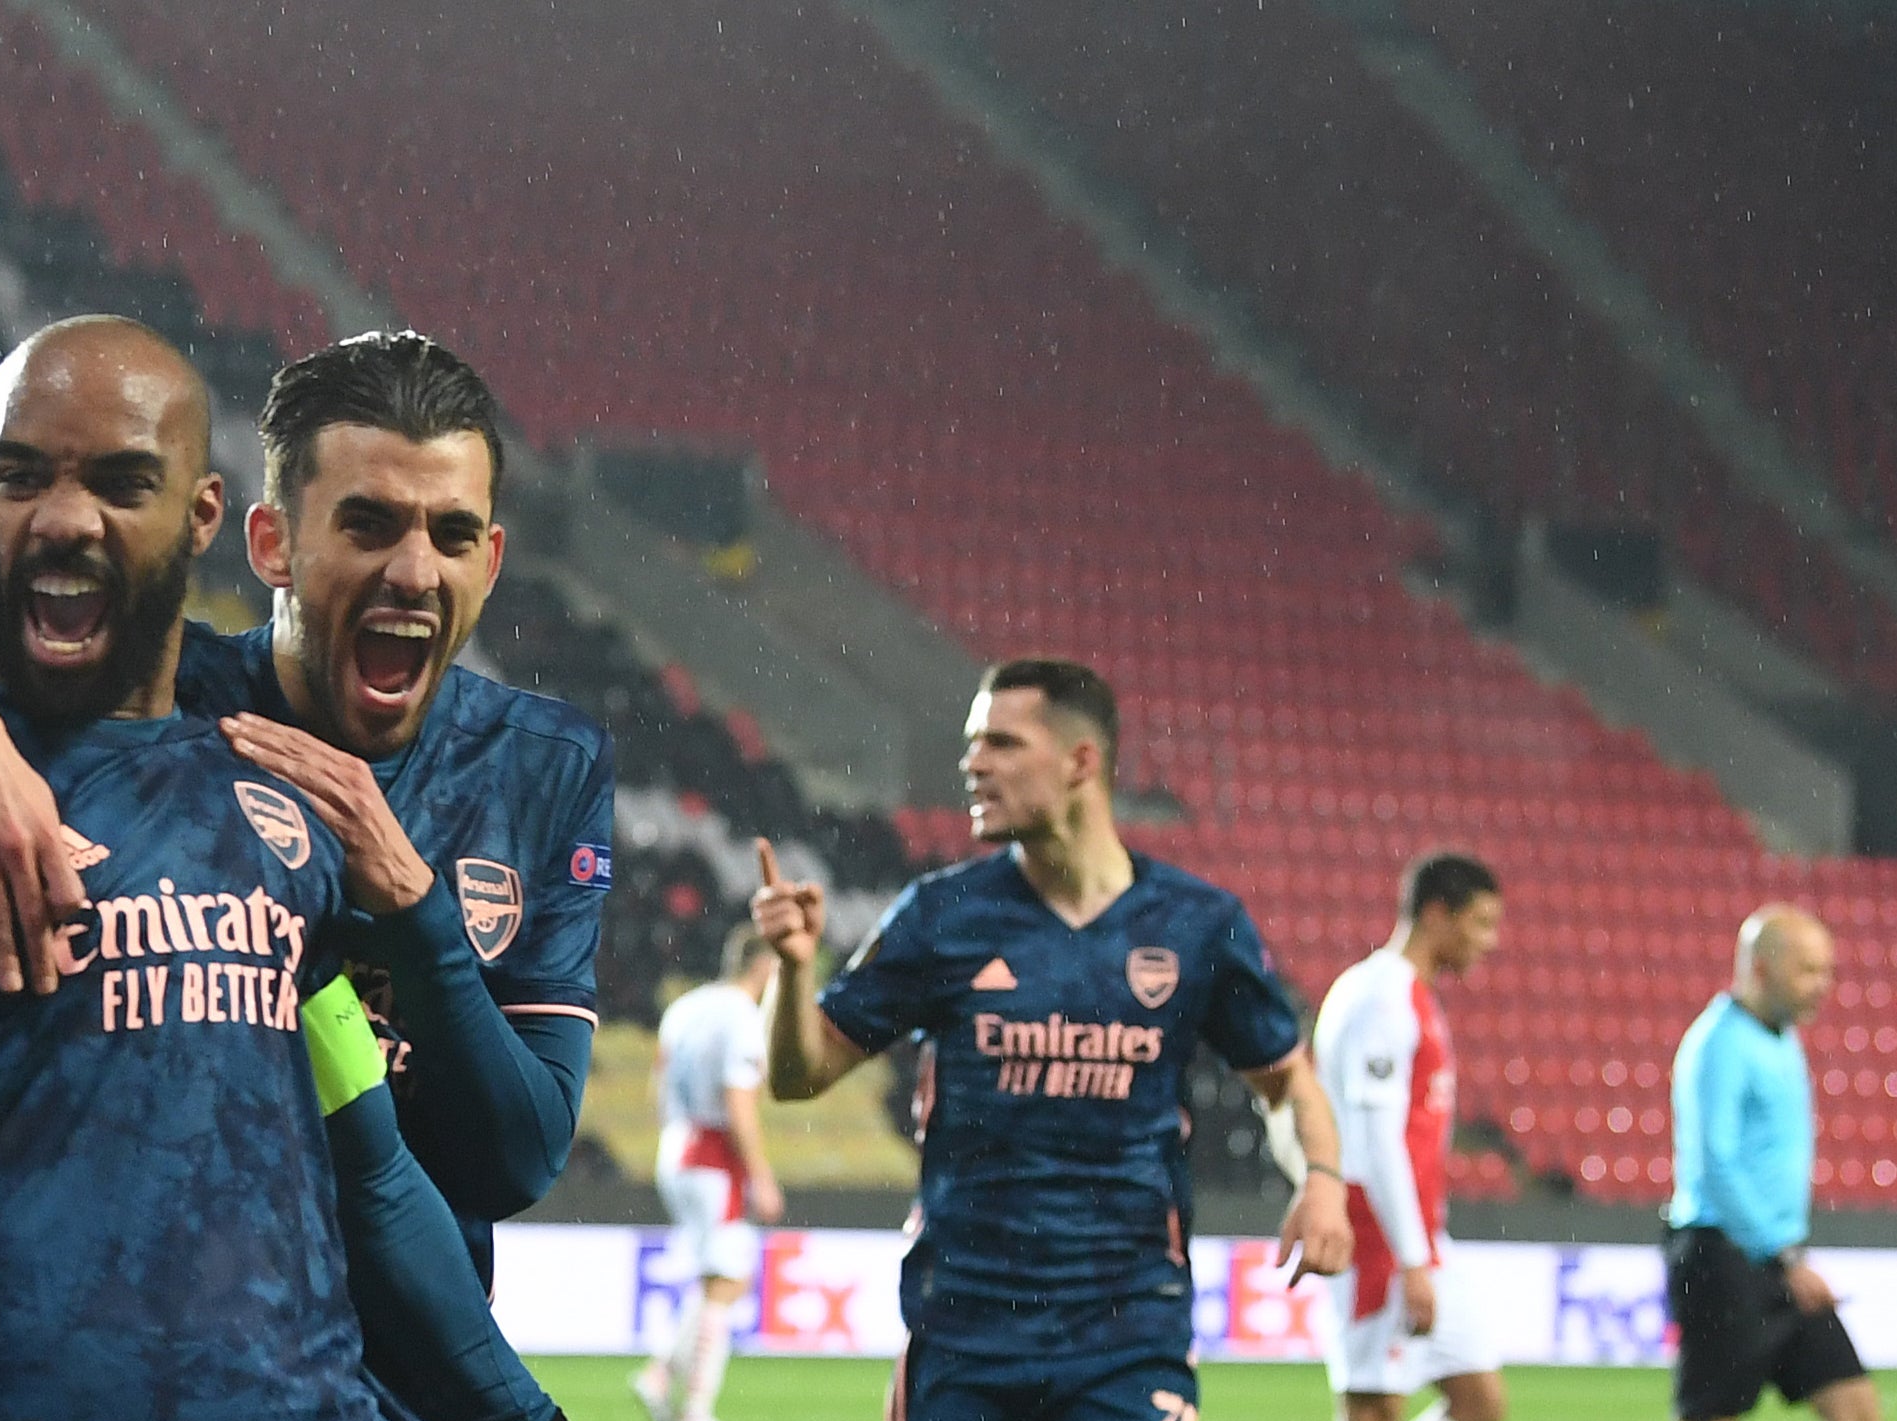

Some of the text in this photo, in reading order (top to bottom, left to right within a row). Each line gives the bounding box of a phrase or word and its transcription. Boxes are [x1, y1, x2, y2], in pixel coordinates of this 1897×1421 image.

[102, 962, 299, 1033] FLY BETTER
[973, 1012, 1164, 1064] Emirates
